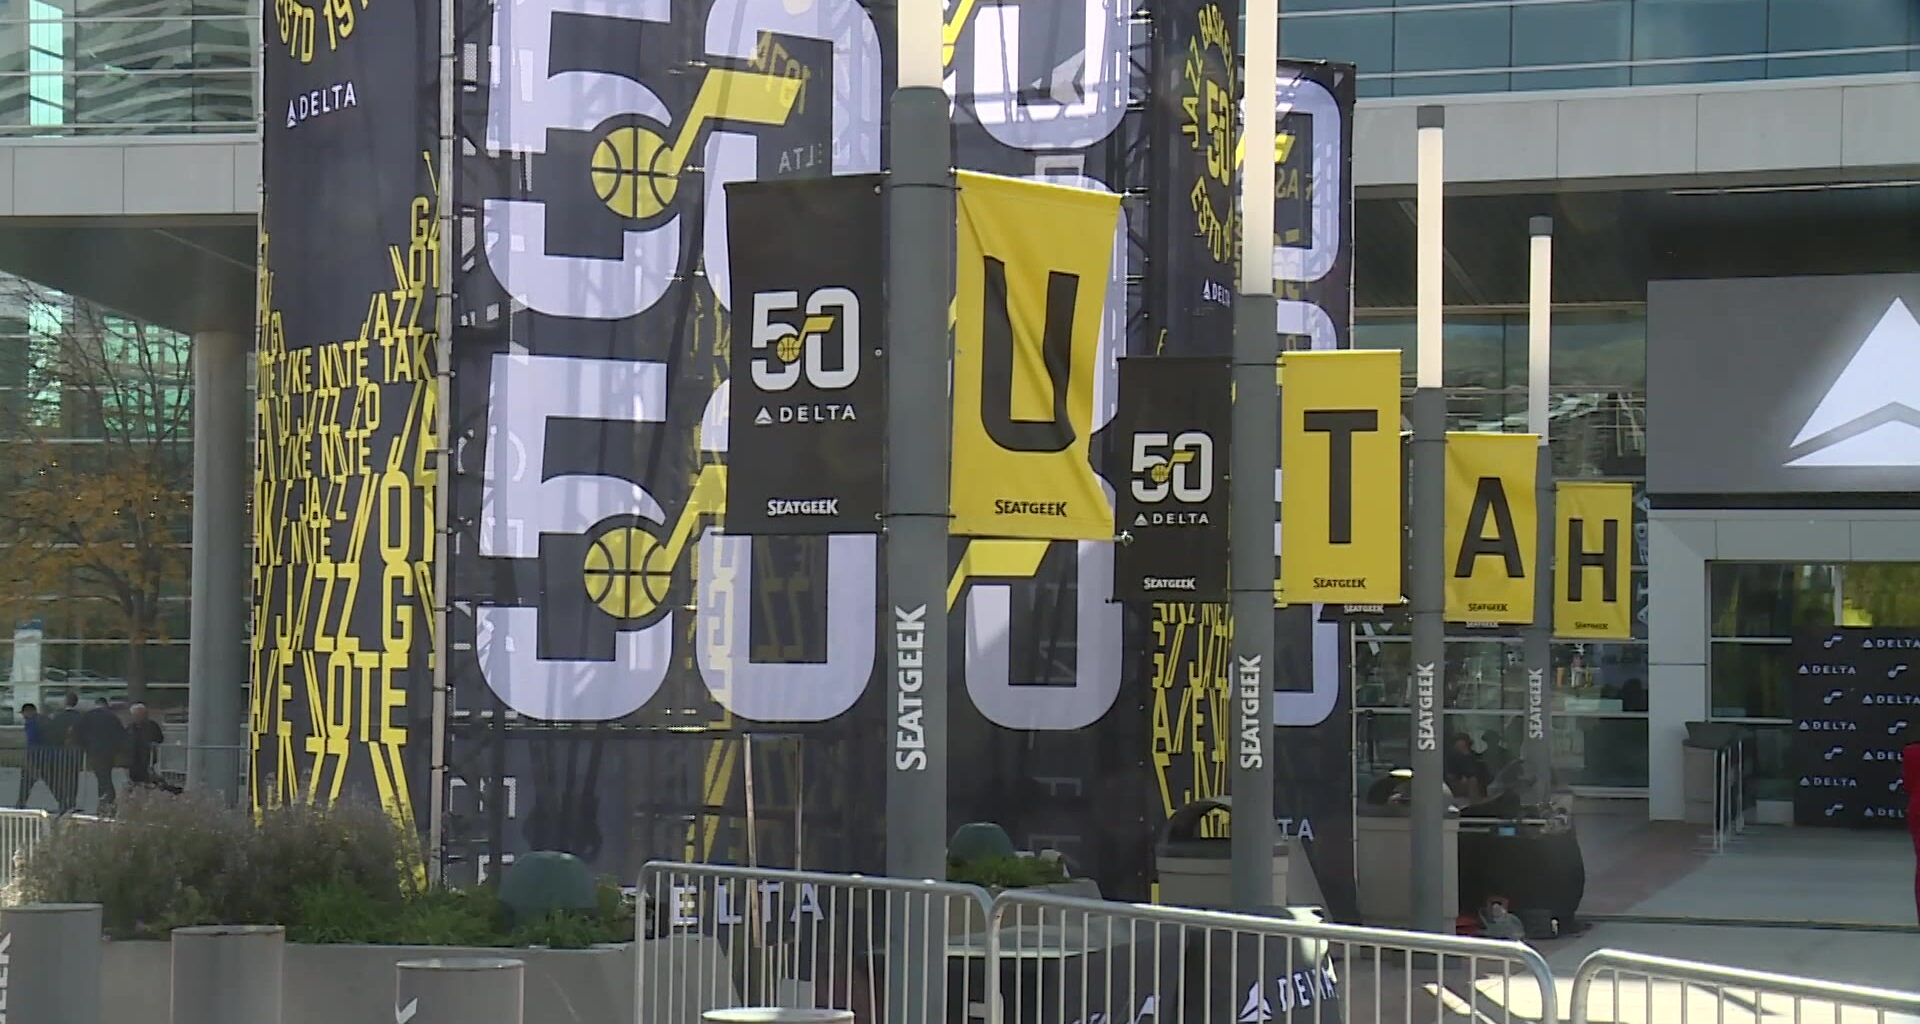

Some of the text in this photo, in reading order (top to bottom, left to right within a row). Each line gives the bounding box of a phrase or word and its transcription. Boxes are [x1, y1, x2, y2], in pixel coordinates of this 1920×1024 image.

[299, 82, 357, 120] DELTA
[381, 331, 439, 383] TAK
[751, 287, 859, 391] 50
[981, 255, 1080, 452] U
[779, 404, 856, 423] DELTA
[1131, 432, 1214, 503] 50
[1304, 410, 1378, 543] T
[767, 499, 838, 516] SEATGEEK
[994, 499, 1068, 518] SEATGEEK
[1152, 512, 1209, 525] DELTA
[1454, 477, 1525, 577] A
[1568, 518, 1618, 602] H
[1144, 577, 1196, 590] SEATGEEK
[1313, 578, 1366, 589] SEATGEEK
[1468, 603, 1508, 613] SEATGEEK
[895, 604, 927, 770] SEATGEEK
[1812, 665, 1856, 675] DELTA
[303, 650, 408, 744] NOTE
[1239, 655, 1263, 768] SEATGEEK
[1417, 662, 1436, 750] SEATGEEK
[1528, 668, 1544, 739] SEATGEEK
[1812, 720, 1856, 730] DELTA
[1877, 751, 1904, 761] DEL
[1813, 776, 1857, 787] DELTA
[1877, 807, 1905, 818] DEL
